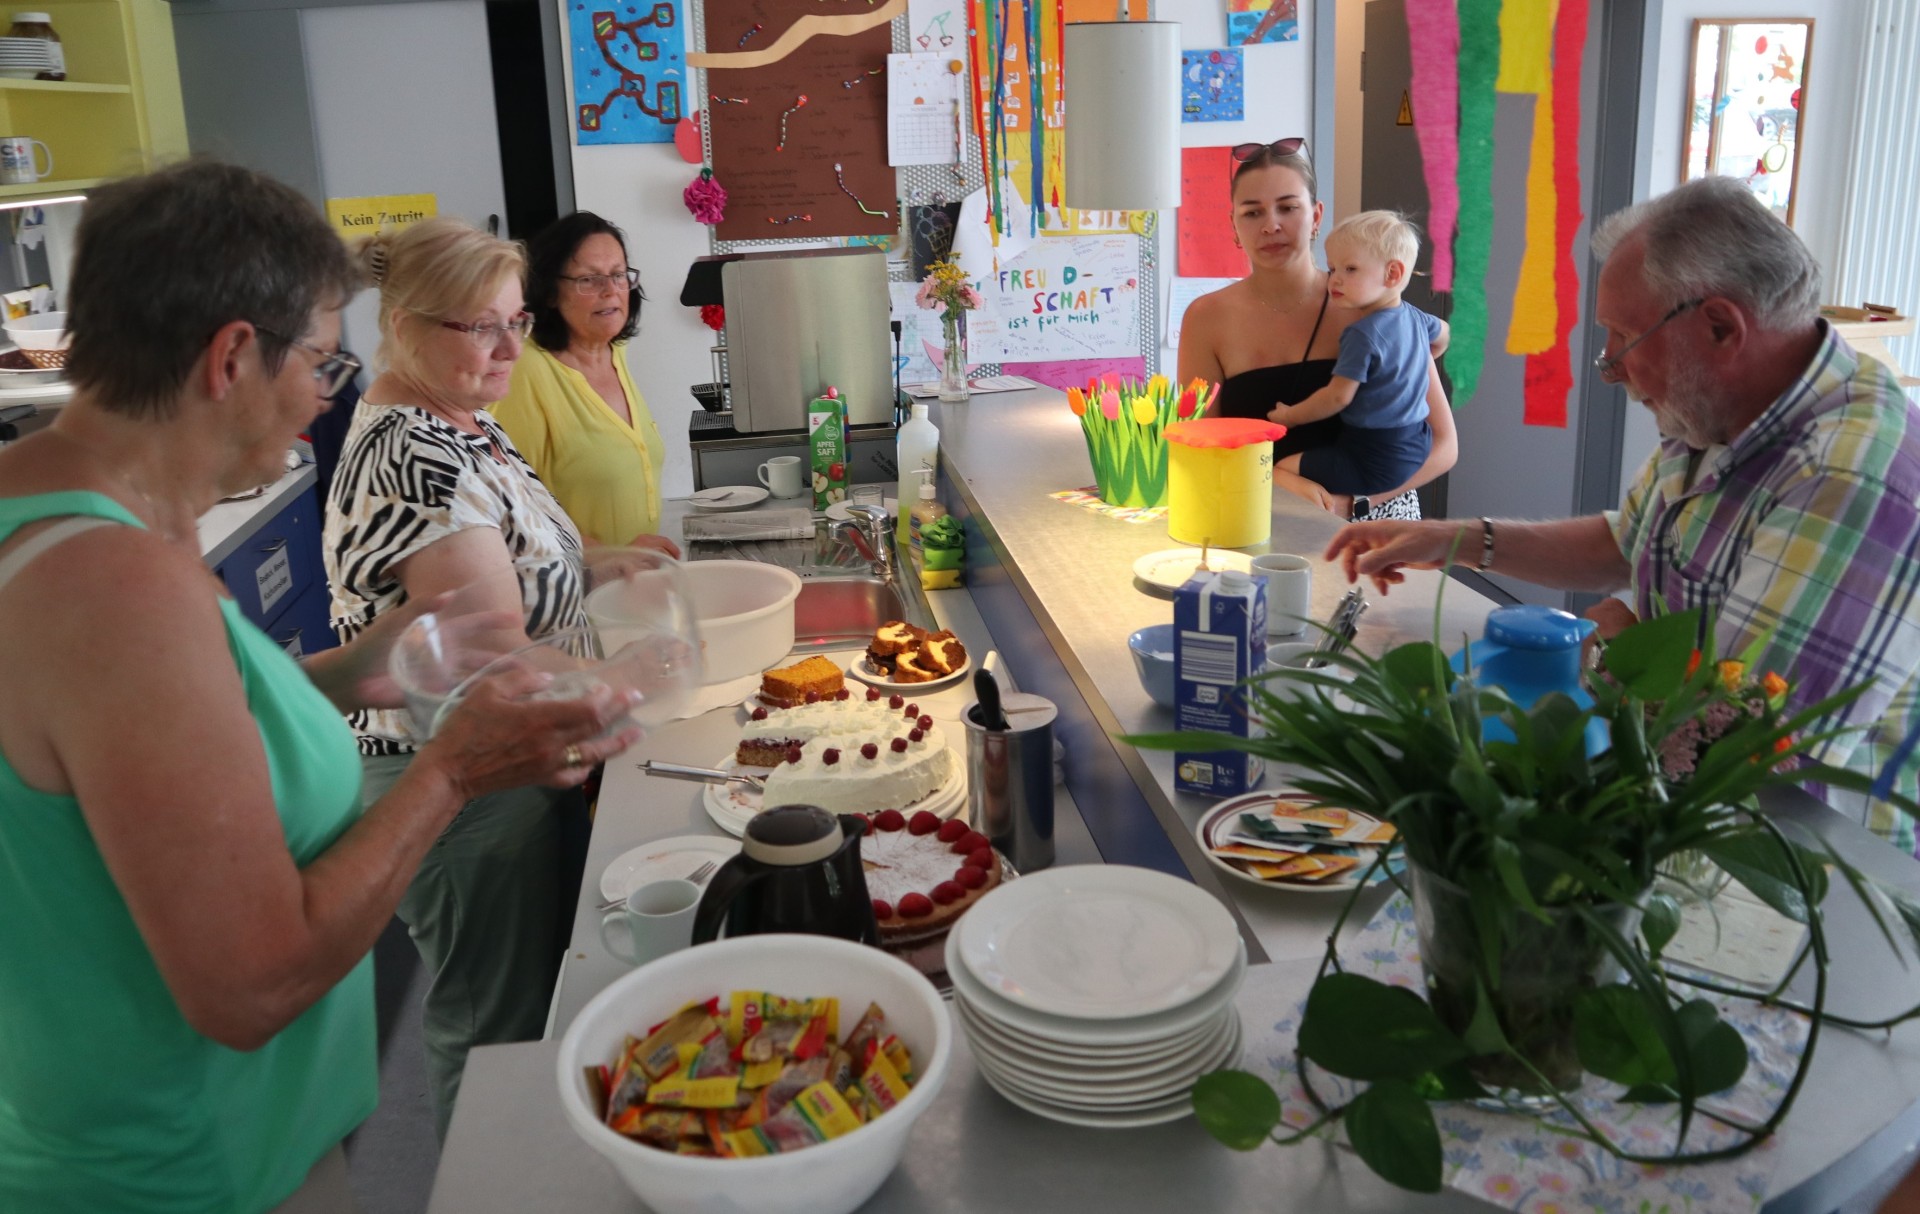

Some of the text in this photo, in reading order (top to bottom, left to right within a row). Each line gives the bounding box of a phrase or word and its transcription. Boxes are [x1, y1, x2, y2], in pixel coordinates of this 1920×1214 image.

[341, 210, 425, 227] Kein Zutritt
[1032, 287, 1114, 314] SCHAFT
[1008, 317, 1029, 330] ist
[1038, 313, 1059, 332] für
[1068, 310, 1099, 324] mich
[816, 448, 836, 456] SAFT
